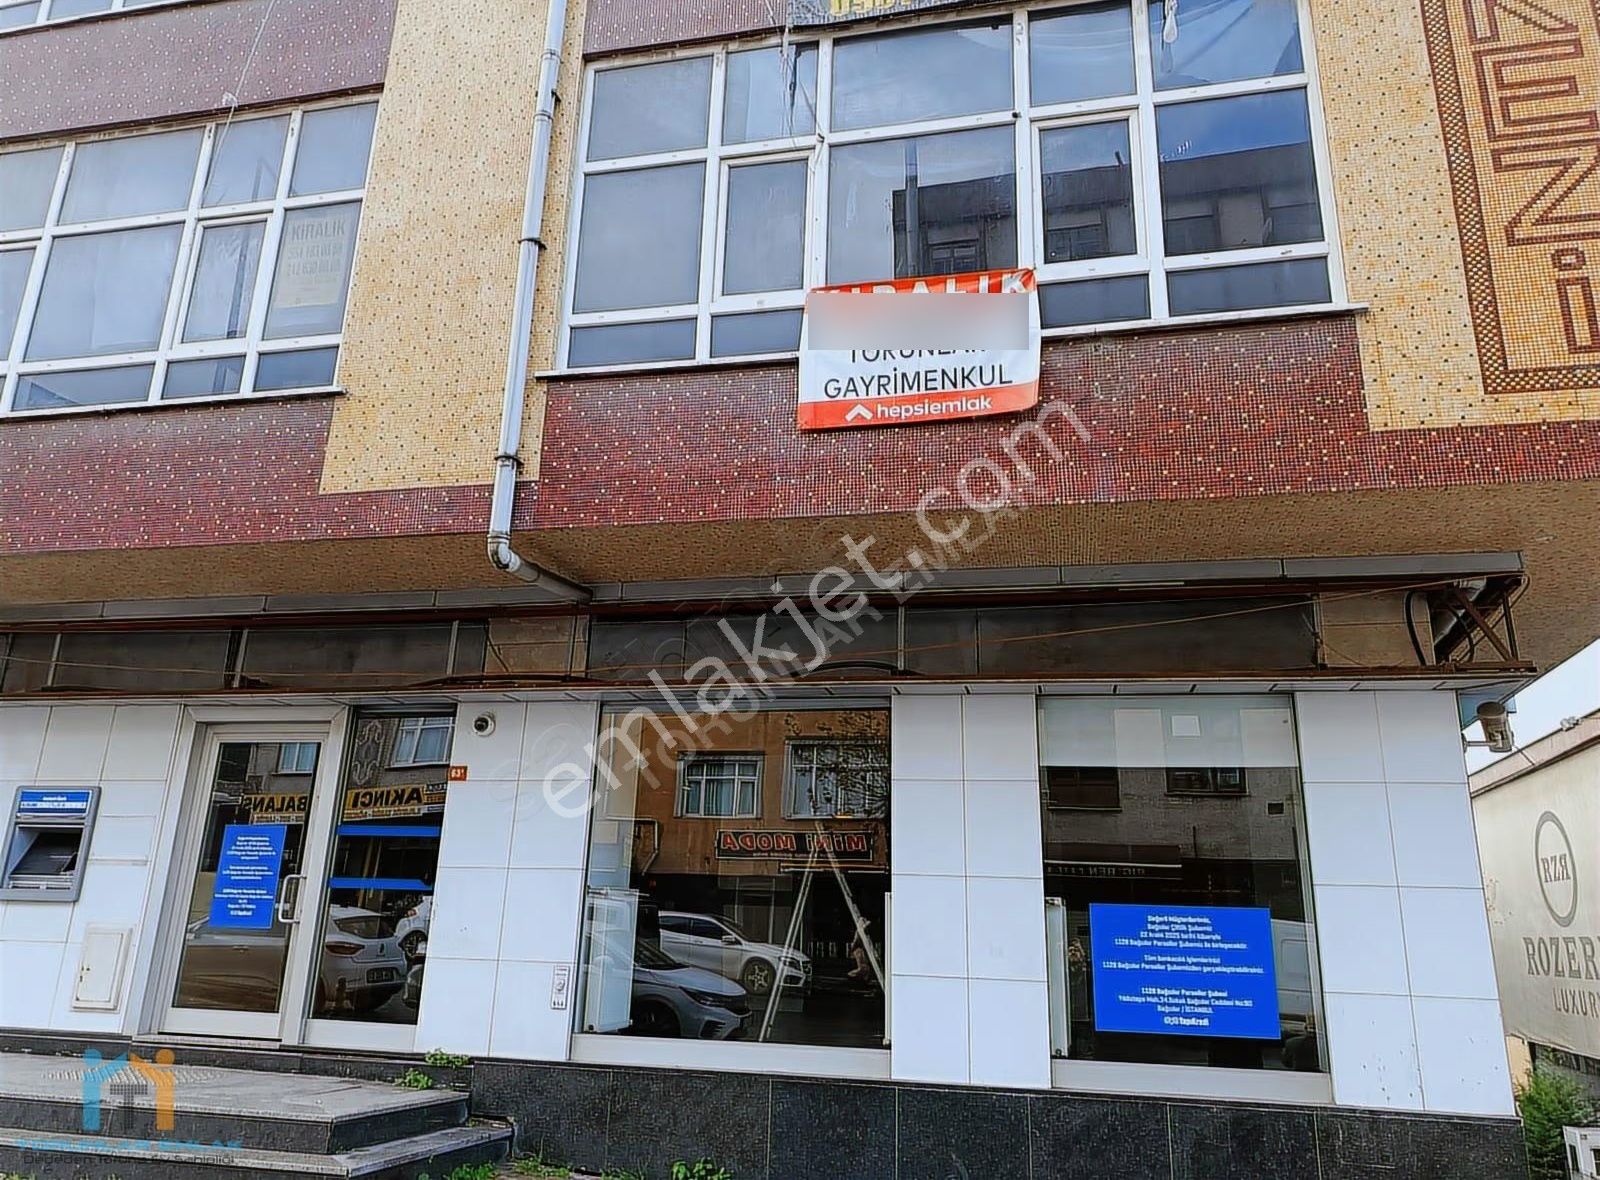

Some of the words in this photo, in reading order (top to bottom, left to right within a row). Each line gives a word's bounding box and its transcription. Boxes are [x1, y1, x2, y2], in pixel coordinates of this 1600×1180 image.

[824, 364, 1012, 398] GAYRİMENKUL
[1523, 936, 1600, 981] ROZER
[1553, 986, 1600, 1019] LUXUR
